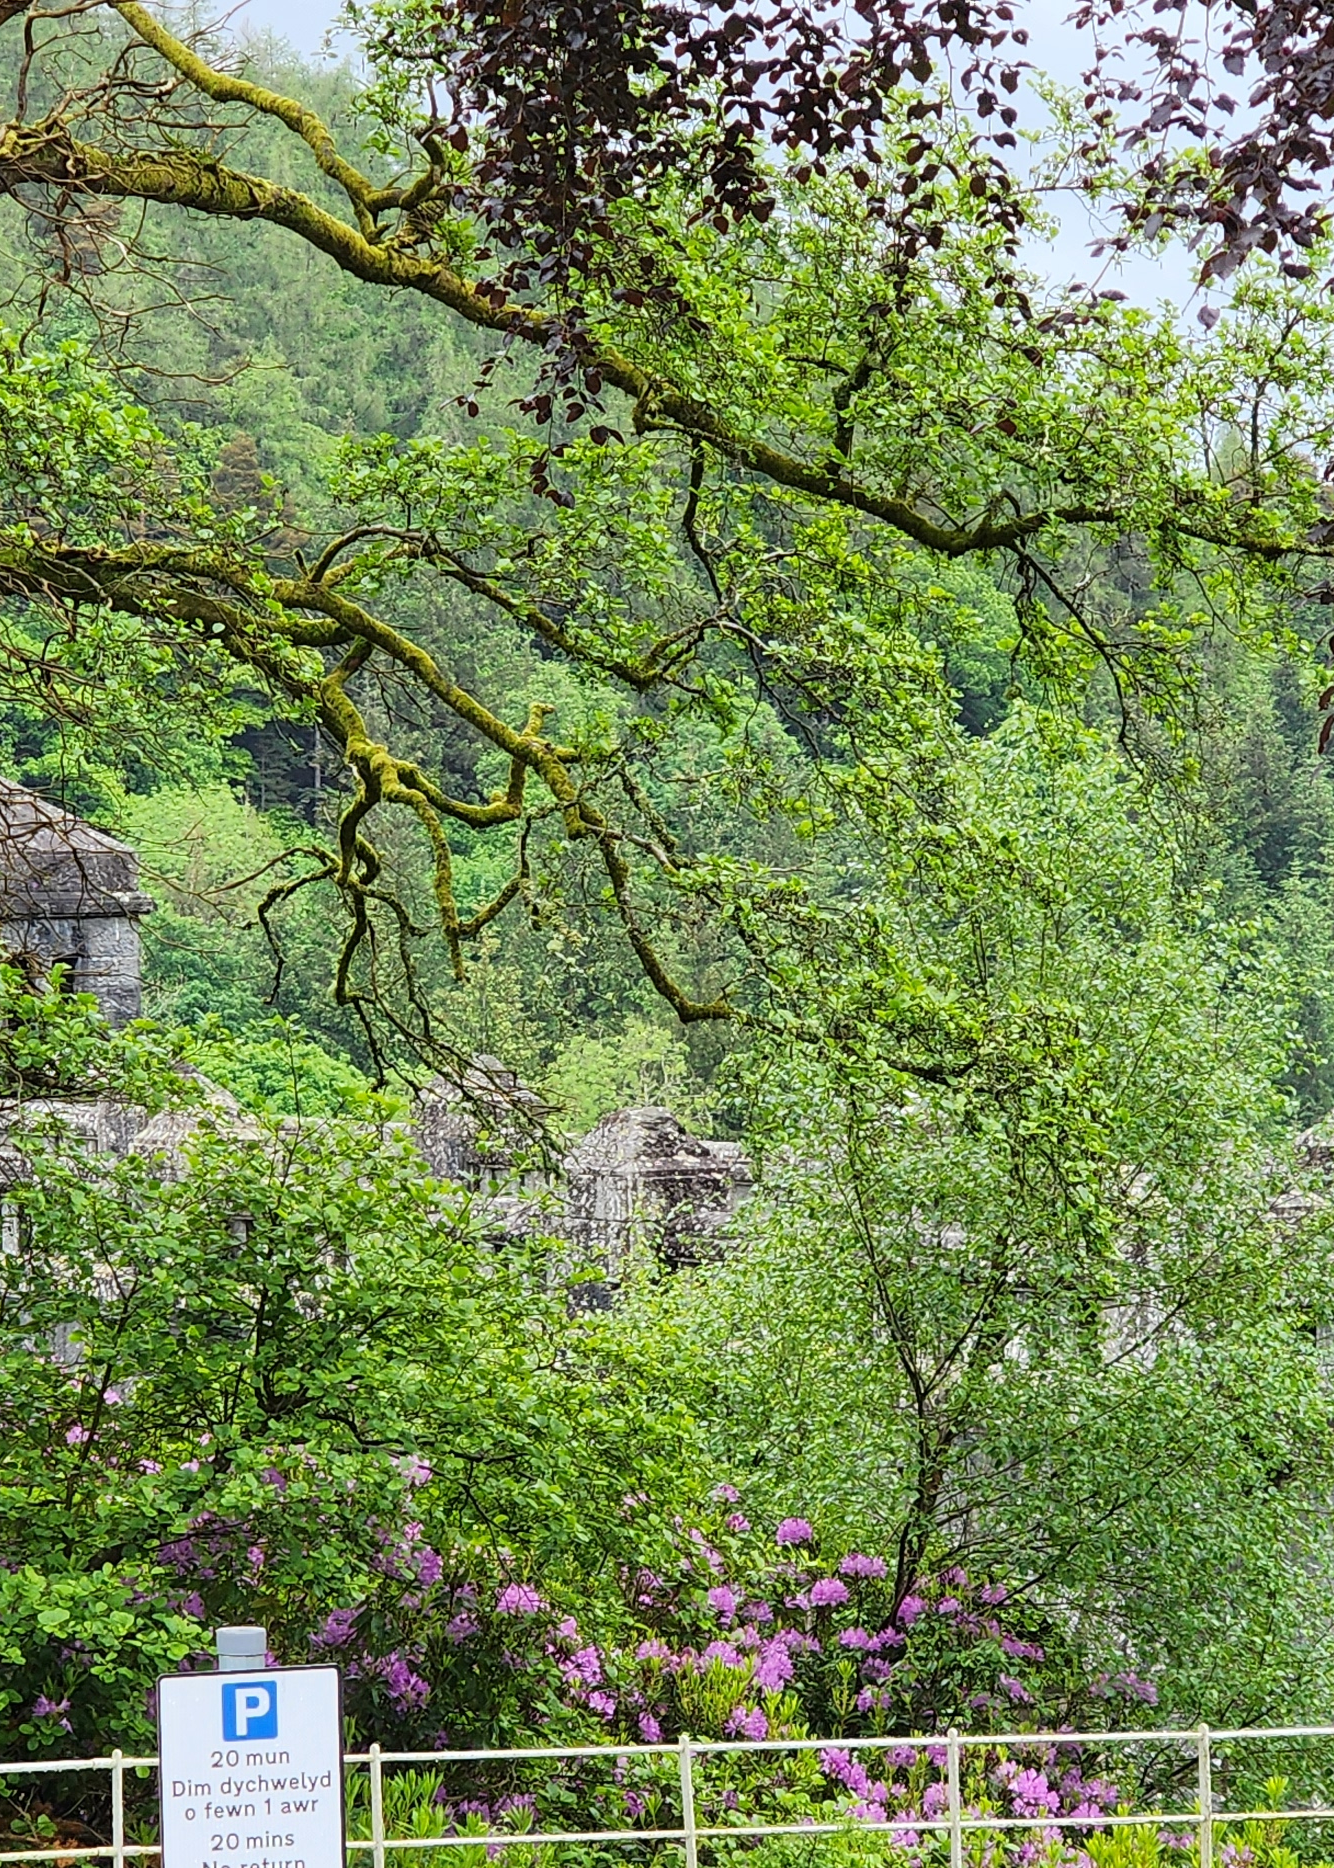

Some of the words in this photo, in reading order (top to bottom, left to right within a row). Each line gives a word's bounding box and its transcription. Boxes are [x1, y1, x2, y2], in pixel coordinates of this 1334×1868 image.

[235, 1687, 270, 1736] P
[211, 1750, 239, 1768] 20
[246, 1751, 290, 1766] mun
[172, 1780, 211, 1797] Dim
[220, 1771, 331, 1797] dychwelyd
[185, 1808, 195, 1820] o
[204, 1802, 255, 1819] fewn
[265, 1798, 271, 1815] 1
[281, 1799, 318, 1813] awr
[211, 1834, 239, 1851] 20
[246, 1831, 294, 1849] mins
